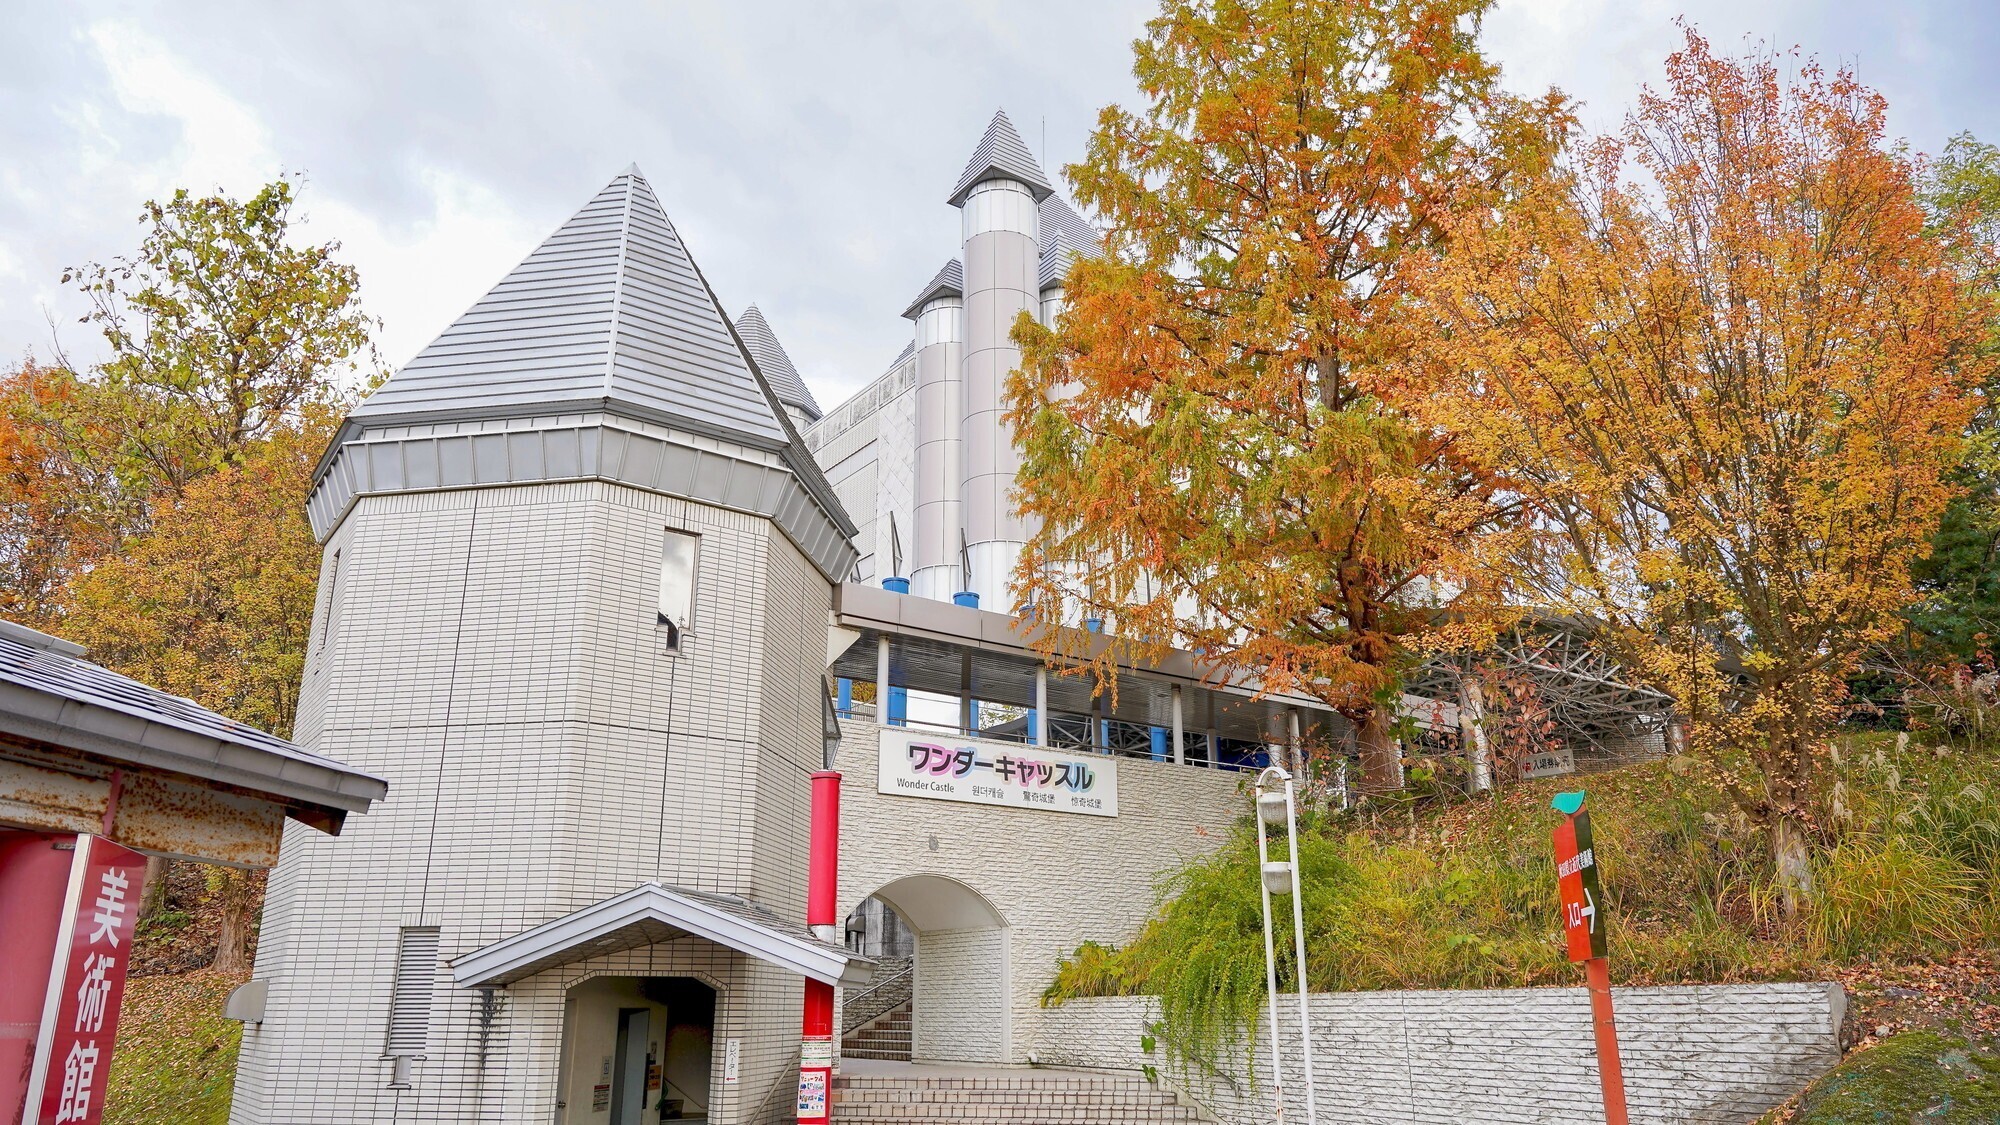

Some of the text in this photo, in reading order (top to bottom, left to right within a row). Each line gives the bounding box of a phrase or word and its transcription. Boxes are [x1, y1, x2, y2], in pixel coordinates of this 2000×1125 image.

[909, 745, 1093, 790] ワンダーキャッスル
[896, 777, 955, 793] Wonder Castle
[972, 785, 1004, 799] 원더캐슬
[1022, 790, 1056, 804] 驚奇城堡
[1071, 796, 1102, 809] 惊奇城堡
[1567, 902, 1582, 929] 入口
[56, 866, 129, 1125] 美術館
[728, 1041, 737, 1075] エレベーター
